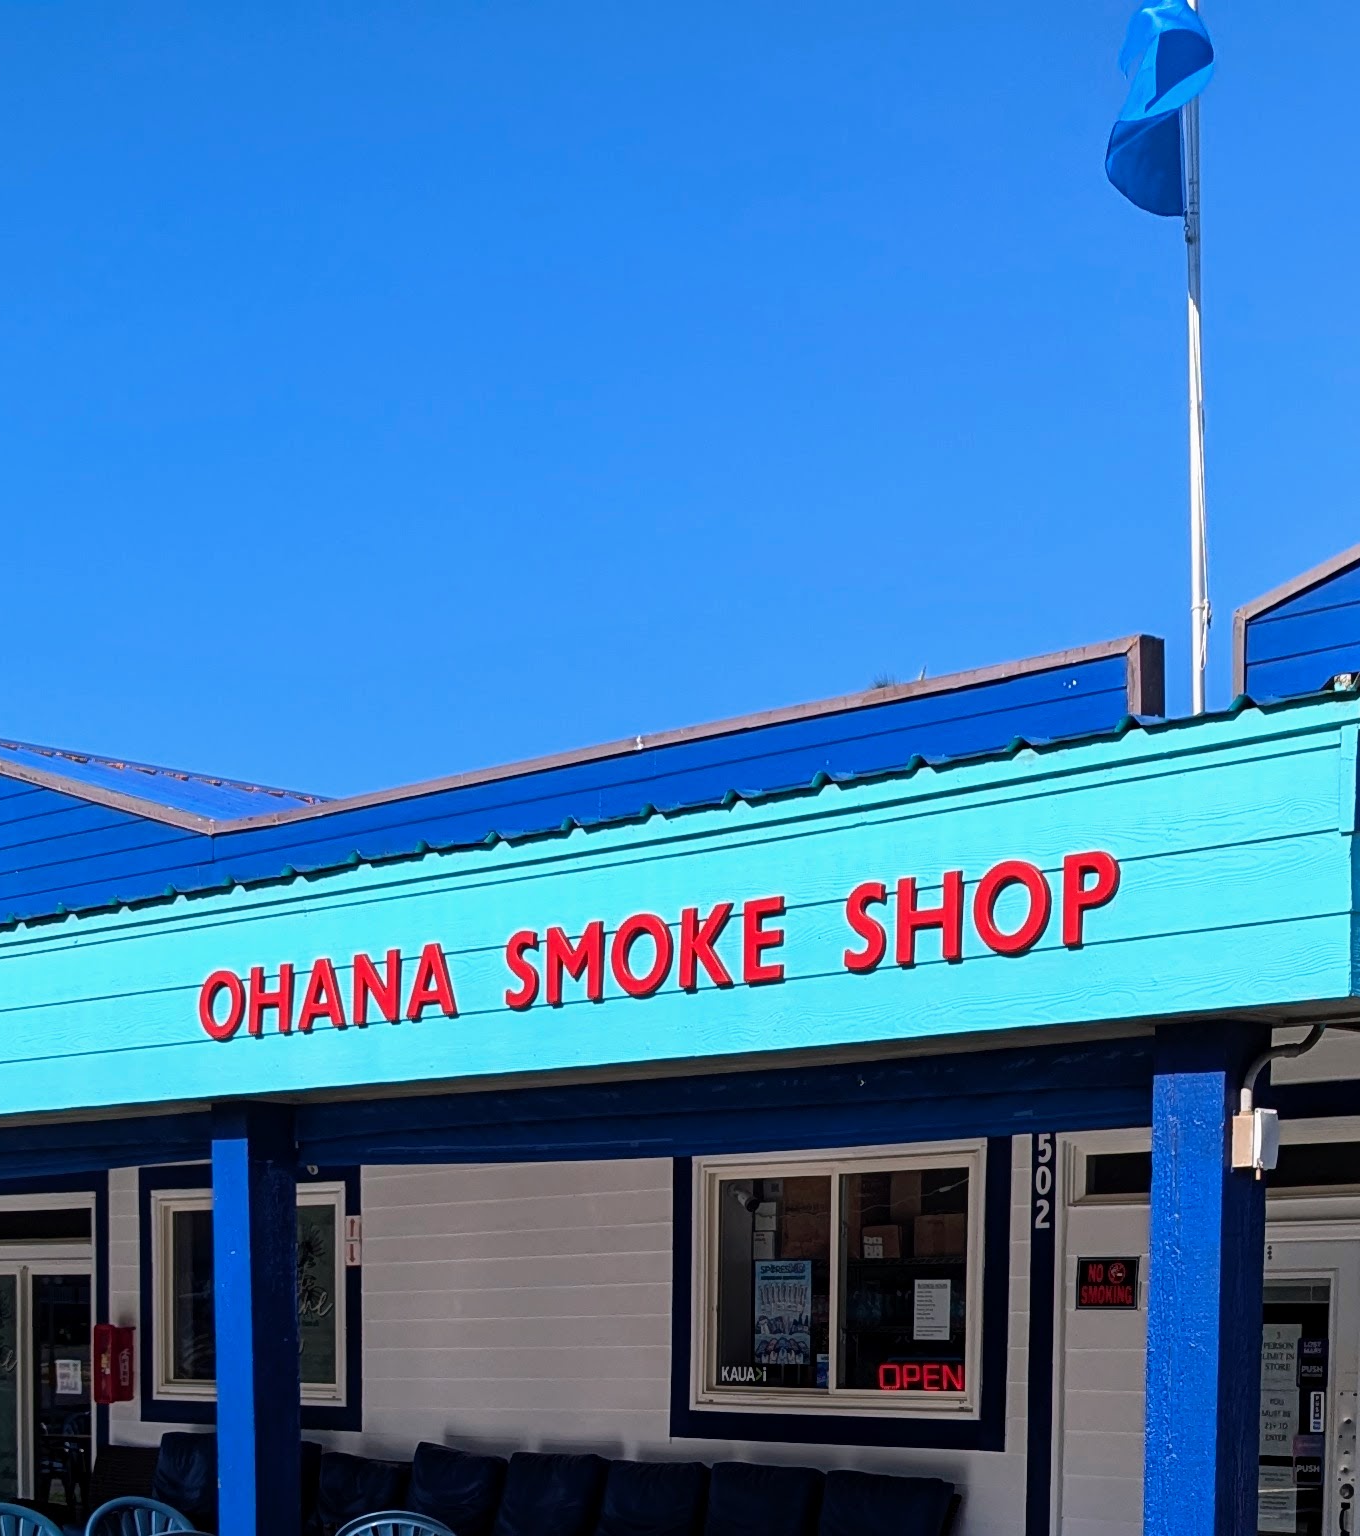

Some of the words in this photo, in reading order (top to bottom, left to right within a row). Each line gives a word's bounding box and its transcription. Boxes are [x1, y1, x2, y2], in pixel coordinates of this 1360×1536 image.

[200, 942, 458, 1041] OHANA
[504, 895, 786, 1010] SMOKE
[843, 850, 1121, 974] SHOP
[1034, 1132, 1053, 1230] 502
[1088, 1263, 1104, 1282] NO
[1081, 1284, 1133, 1305] SMOKING
[1263, 1341, 1294, 1350] PERSON
[1265, 1363, 1291, 1371] STORE
[1301, 1365, 1323, 1373] PUSH
[877, 1363, 965, 1391] OPEN
[1296, 1464, 1321, 1473] PUSH
